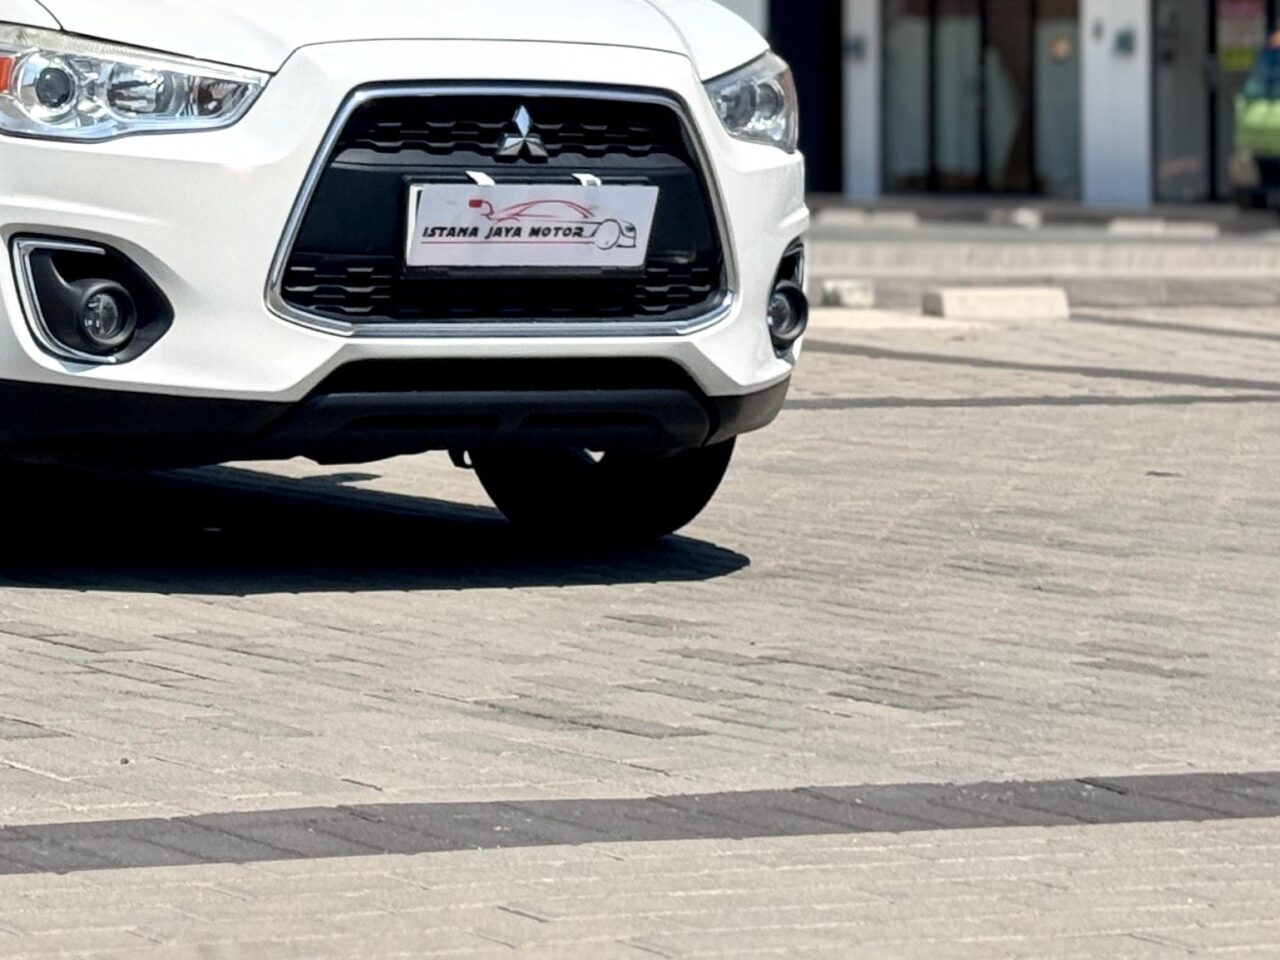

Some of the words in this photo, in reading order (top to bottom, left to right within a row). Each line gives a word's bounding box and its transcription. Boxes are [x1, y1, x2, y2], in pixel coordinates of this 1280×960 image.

[422, 225, 479, 238] ISTANA
[484, 225, 522, 240] JAYA
[528, 225, 585, 238] MOTOR
